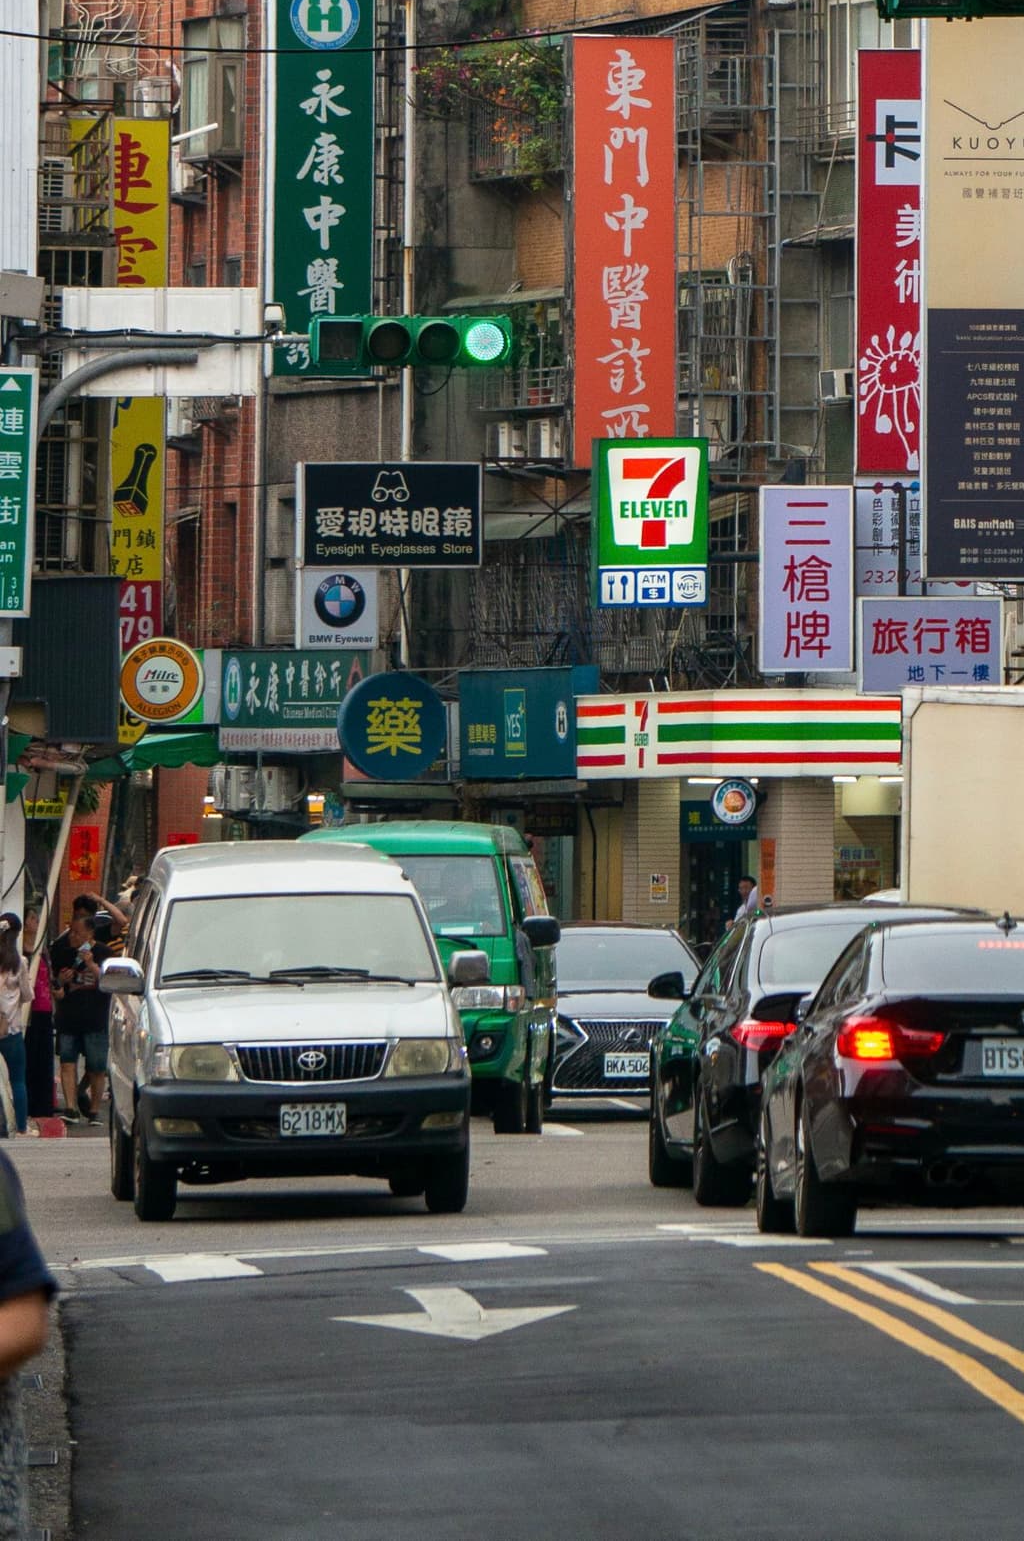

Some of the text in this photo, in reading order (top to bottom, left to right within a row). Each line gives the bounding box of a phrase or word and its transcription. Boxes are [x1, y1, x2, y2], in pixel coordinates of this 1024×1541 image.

[316, 507, 473, 538] 愛視特眼鏡
[316, 544, 473, 556] Eyesight Eyeglasses Store
[642, 574, 666, 584] ATM
[782, 501, 832, 659] 三槍牌
[309, 634, 373, 646] BMW Eyewear
[872, 617, 991, 655] 旅行箱
[907, 664, 990, 681] 地下一樓
[366, 697, 422, 756] 藥
[507, 714, 521, 738] YES
[282, 1109, 345, 1131] 6218-MX
